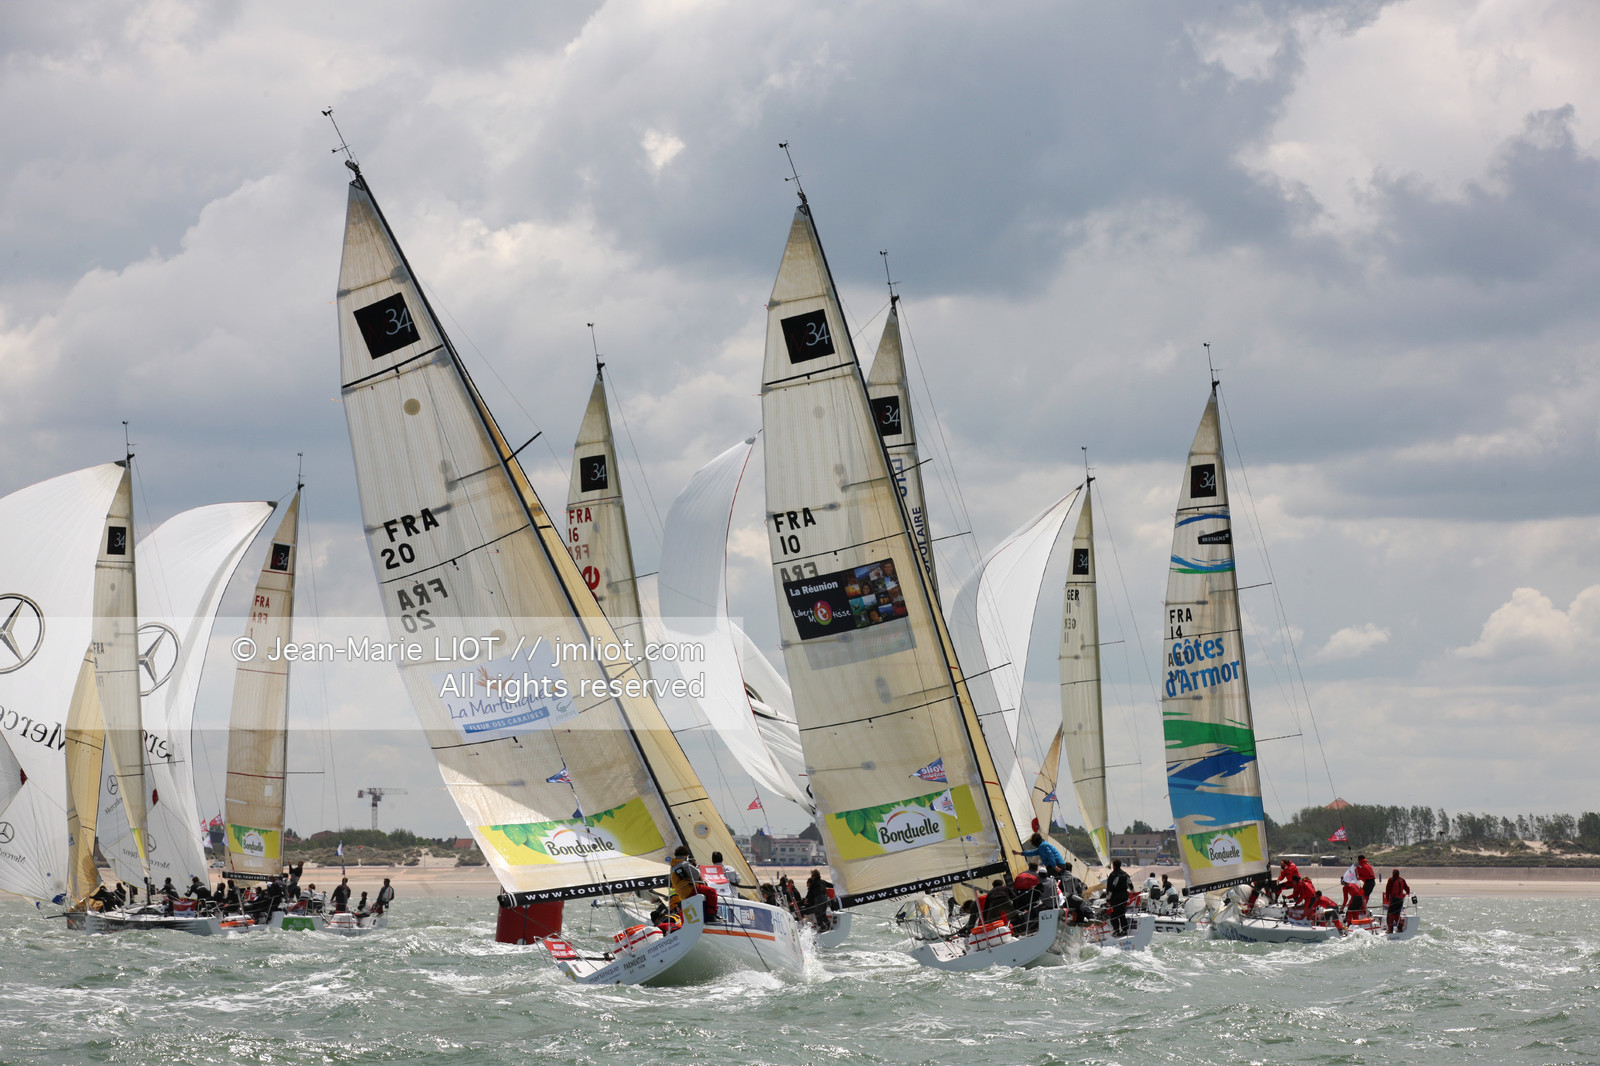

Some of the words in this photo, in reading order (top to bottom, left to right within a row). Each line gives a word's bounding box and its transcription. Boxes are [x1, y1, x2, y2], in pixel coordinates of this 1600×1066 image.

[569, 507, 593, 525] FRA
[772, 507, 817, 533] FRA
[383, 508, 440, 543] FRA
[568, 527, 580, 543] 16
[780, 534, 801, 555] 10
[380, 543, 416, 570] 20
[790, 588, 801, 597] La
[801, 581, 839, 595] Réunion
[1066, 589, 1080, 601] GER
[254, 595, 270, 608] FRA
[1169, 608, 1193, 624] FRA
[1170, 625, 1183, 640] 14
[1172, 637, 1225, 667] Côtes
[1165, 660, 1240, 698] d'Armor
[447, 703, 468, 720] La
[469, 722, 491, 731] FLEUR
[492, 720, 506, 728] DES
[878, 817, 940, 846] Bonduelle
[243, 839, 264, 853] Bonduelle
[545, 837, 615, 858] Bonduelle
[1208, 845, 1240, 862] Bonduelle
[525, 876, 666, 902] www.tourvoile.fr
[854, 870, 979, 904] www.tourvoile.fr
[1190, 877, 1253, 895] www.tourvoile.fr
[647, 935, 679, 954] martinique
[588, 965, 620, 984] martinique
